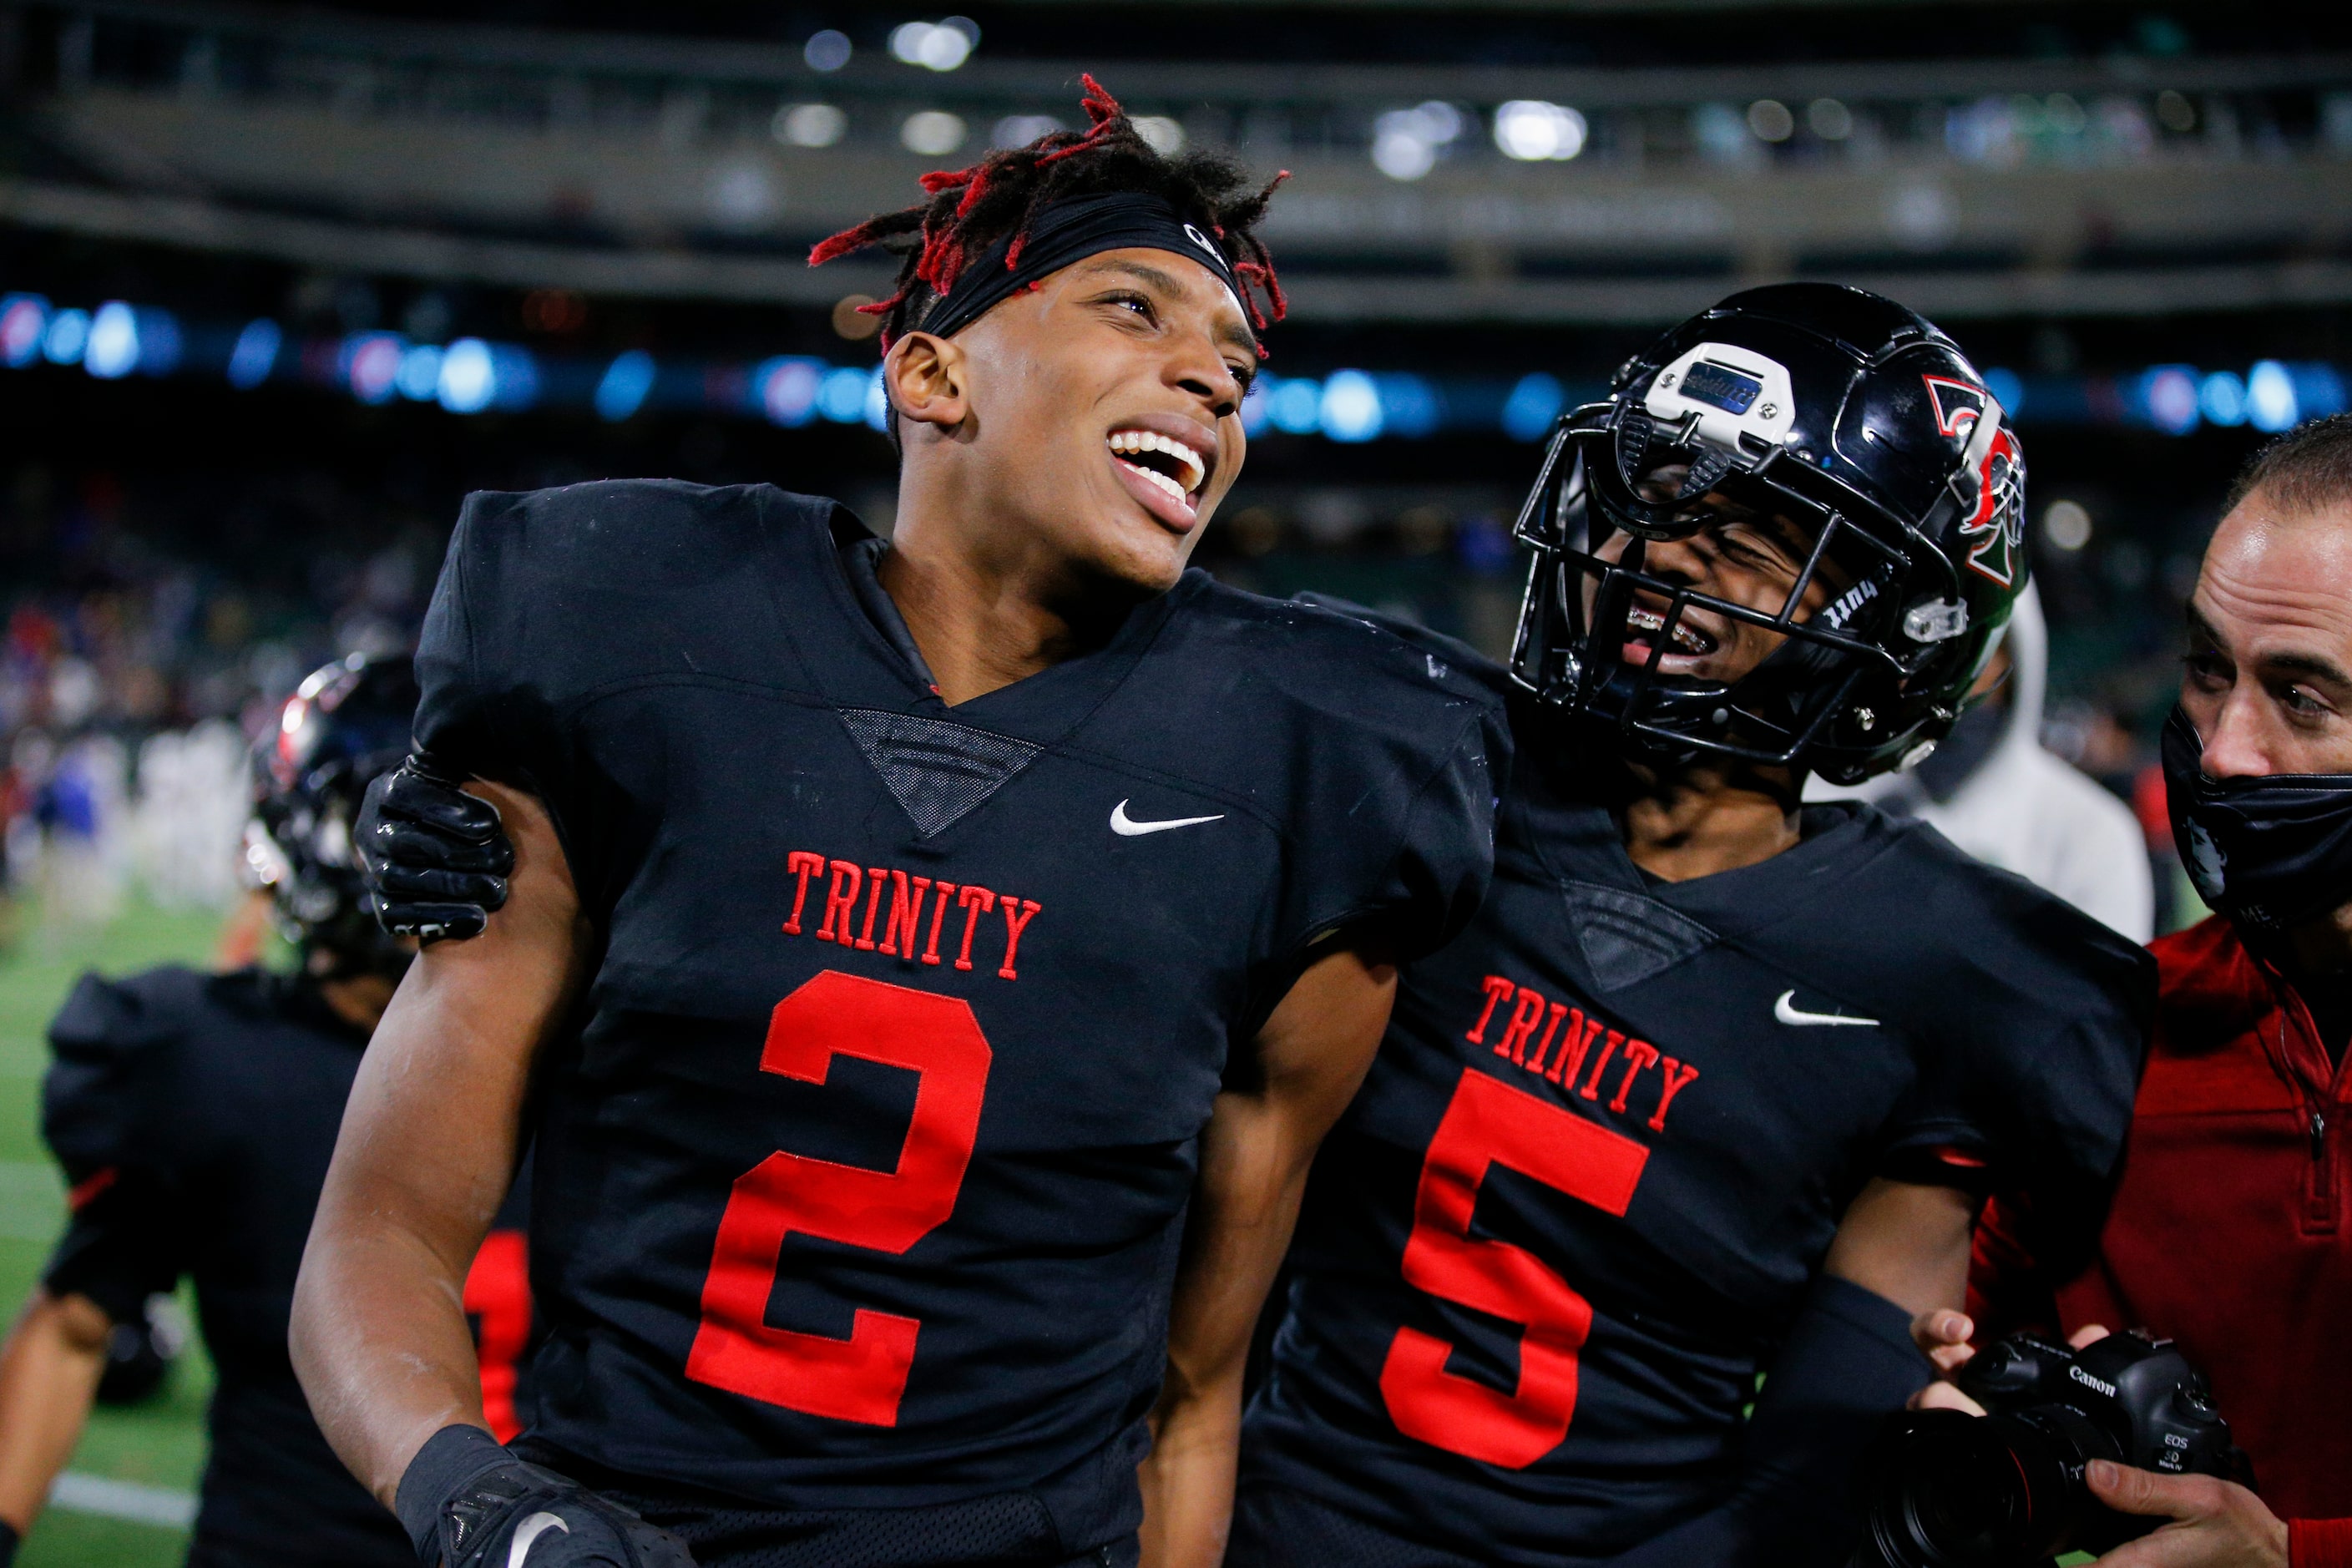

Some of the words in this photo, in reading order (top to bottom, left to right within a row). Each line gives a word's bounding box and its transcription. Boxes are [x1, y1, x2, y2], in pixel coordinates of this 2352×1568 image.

[781, 851, 1043, 981] TRINITY
[1465, 974, 1700, 1134] TRINITY
[684, 969, 993, 1428] 2
[1379, 1066, 1651, 1471] 5
[2069, 1364, 2117, 1398] Canon
[2158, 1459, 2174, 1469] Mark
[2164, 1433, 2188, 1449] EOS
[2164, 1450, 2180, 1464] 5D
